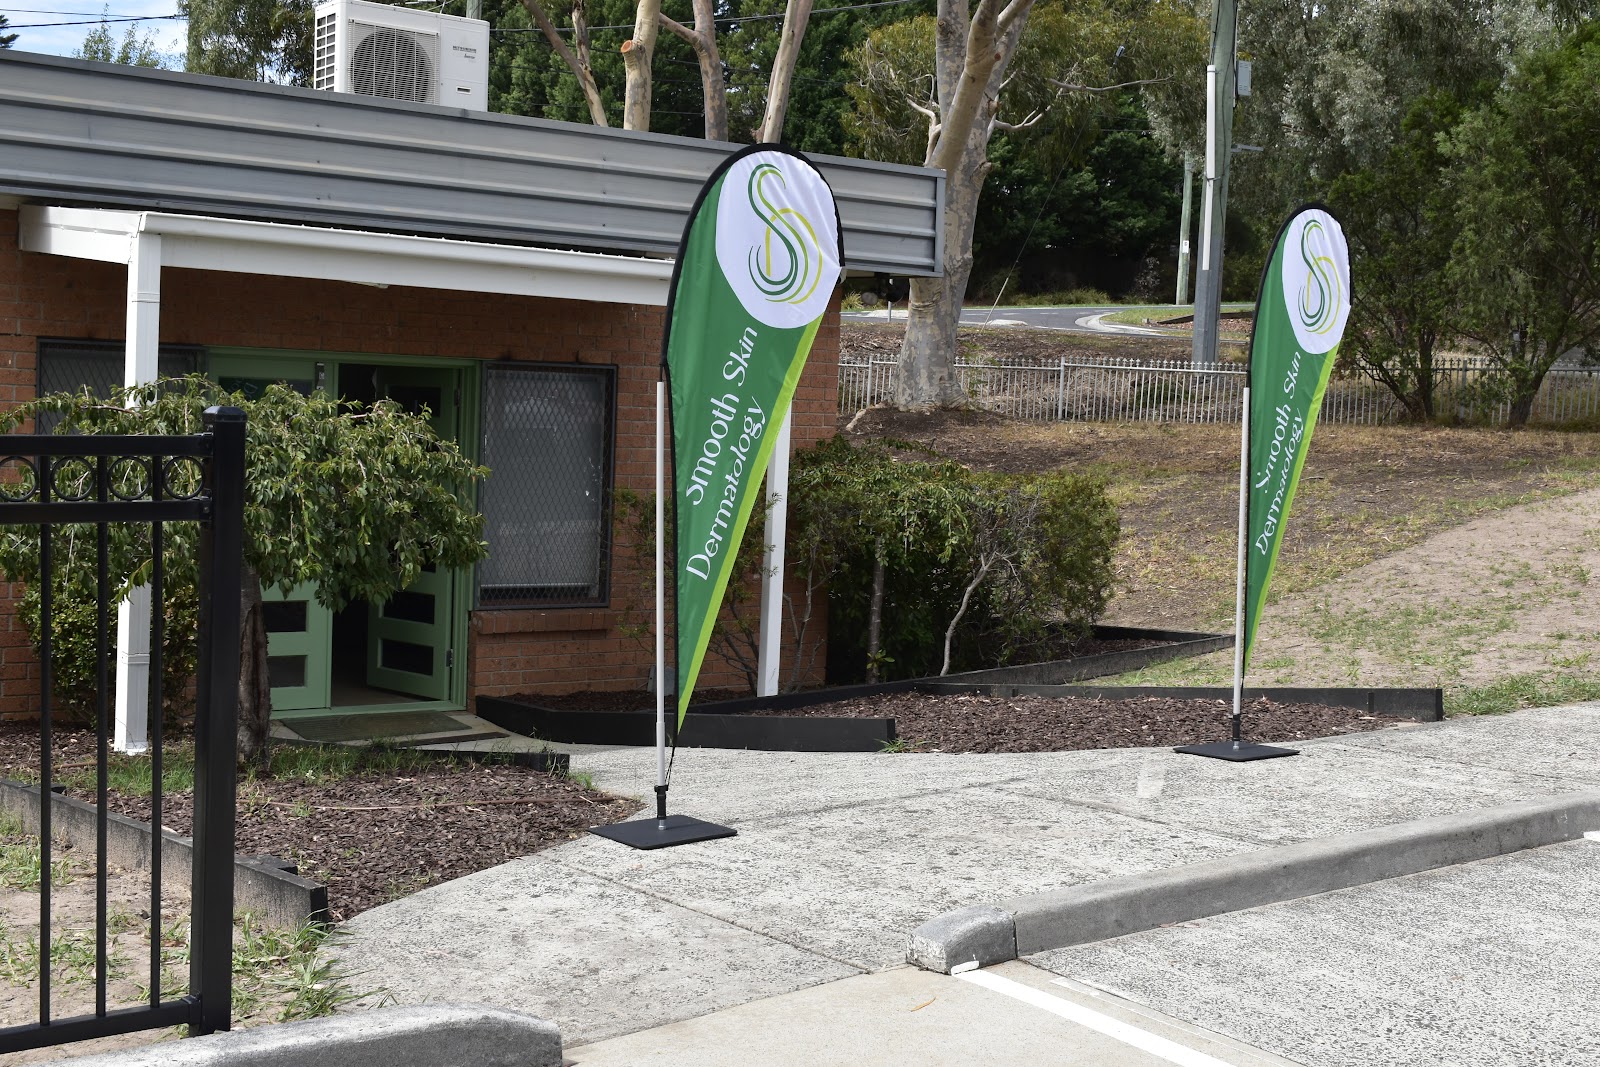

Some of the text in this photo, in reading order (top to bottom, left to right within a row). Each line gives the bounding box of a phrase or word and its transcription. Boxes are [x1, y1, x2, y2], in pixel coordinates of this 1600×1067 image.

[685, 326, 758, 506] Smooth Skin
[685, 395, 766, 581] Dermatology
[1255, 351, 1302, 494] Smooth Skin
[1255, 407, 1304, 556] Dermatology
